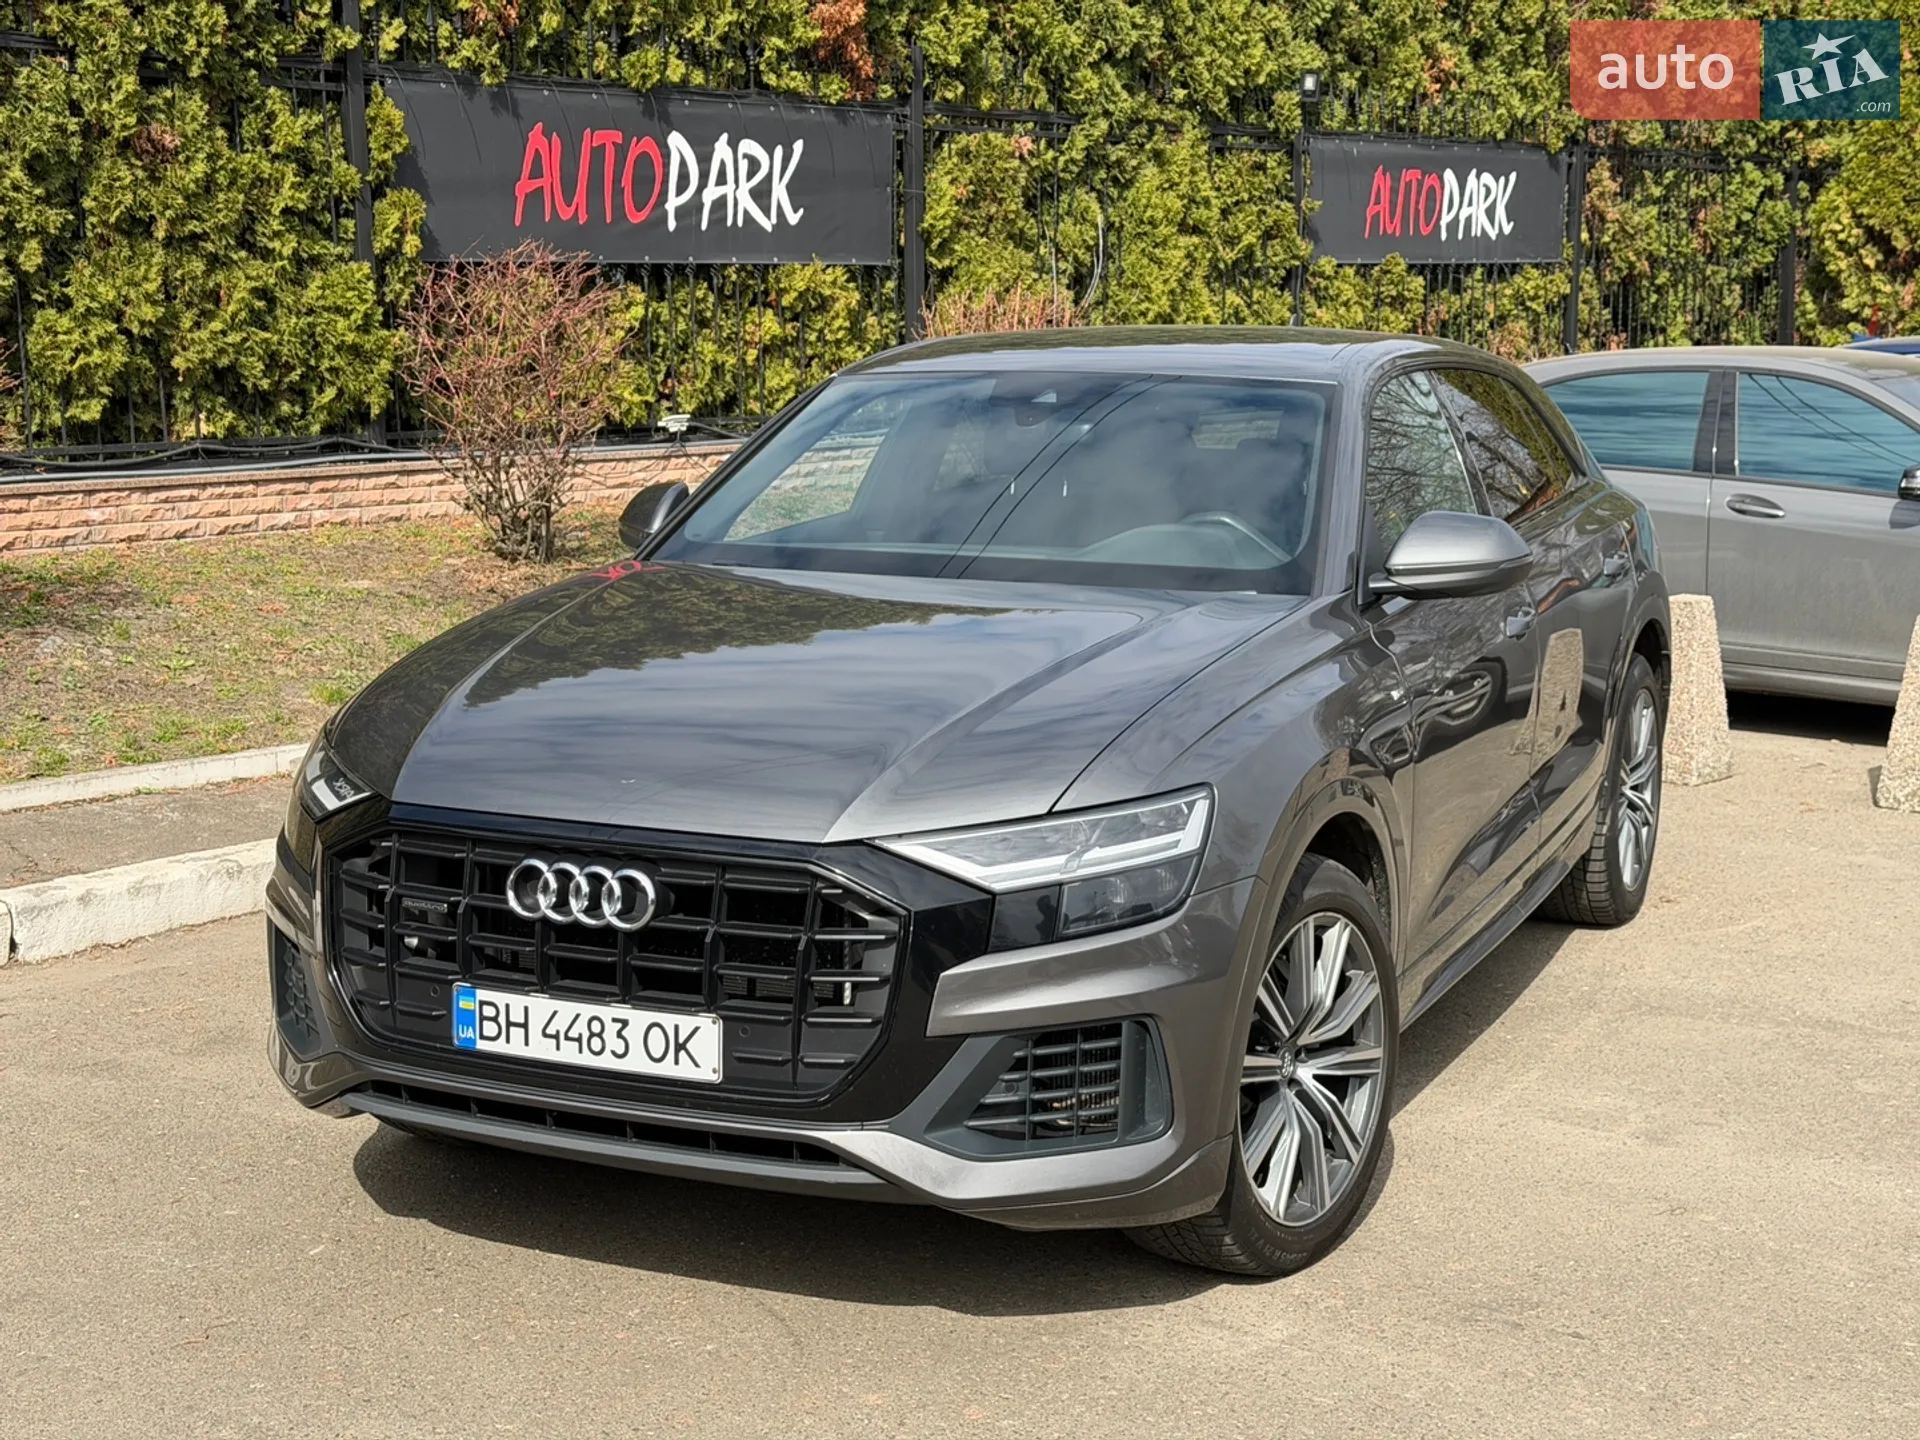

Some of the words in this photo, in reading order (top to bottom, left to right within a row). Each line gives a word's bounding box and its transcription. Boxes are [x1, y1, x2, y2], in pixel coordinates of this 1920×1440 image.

[458, 1024, 475, 1040] UA
[478, 1000, 530, 1047] BH
[541, 1010, 630, 1060] 4483
[643, 1021, 701, 1069] OK
